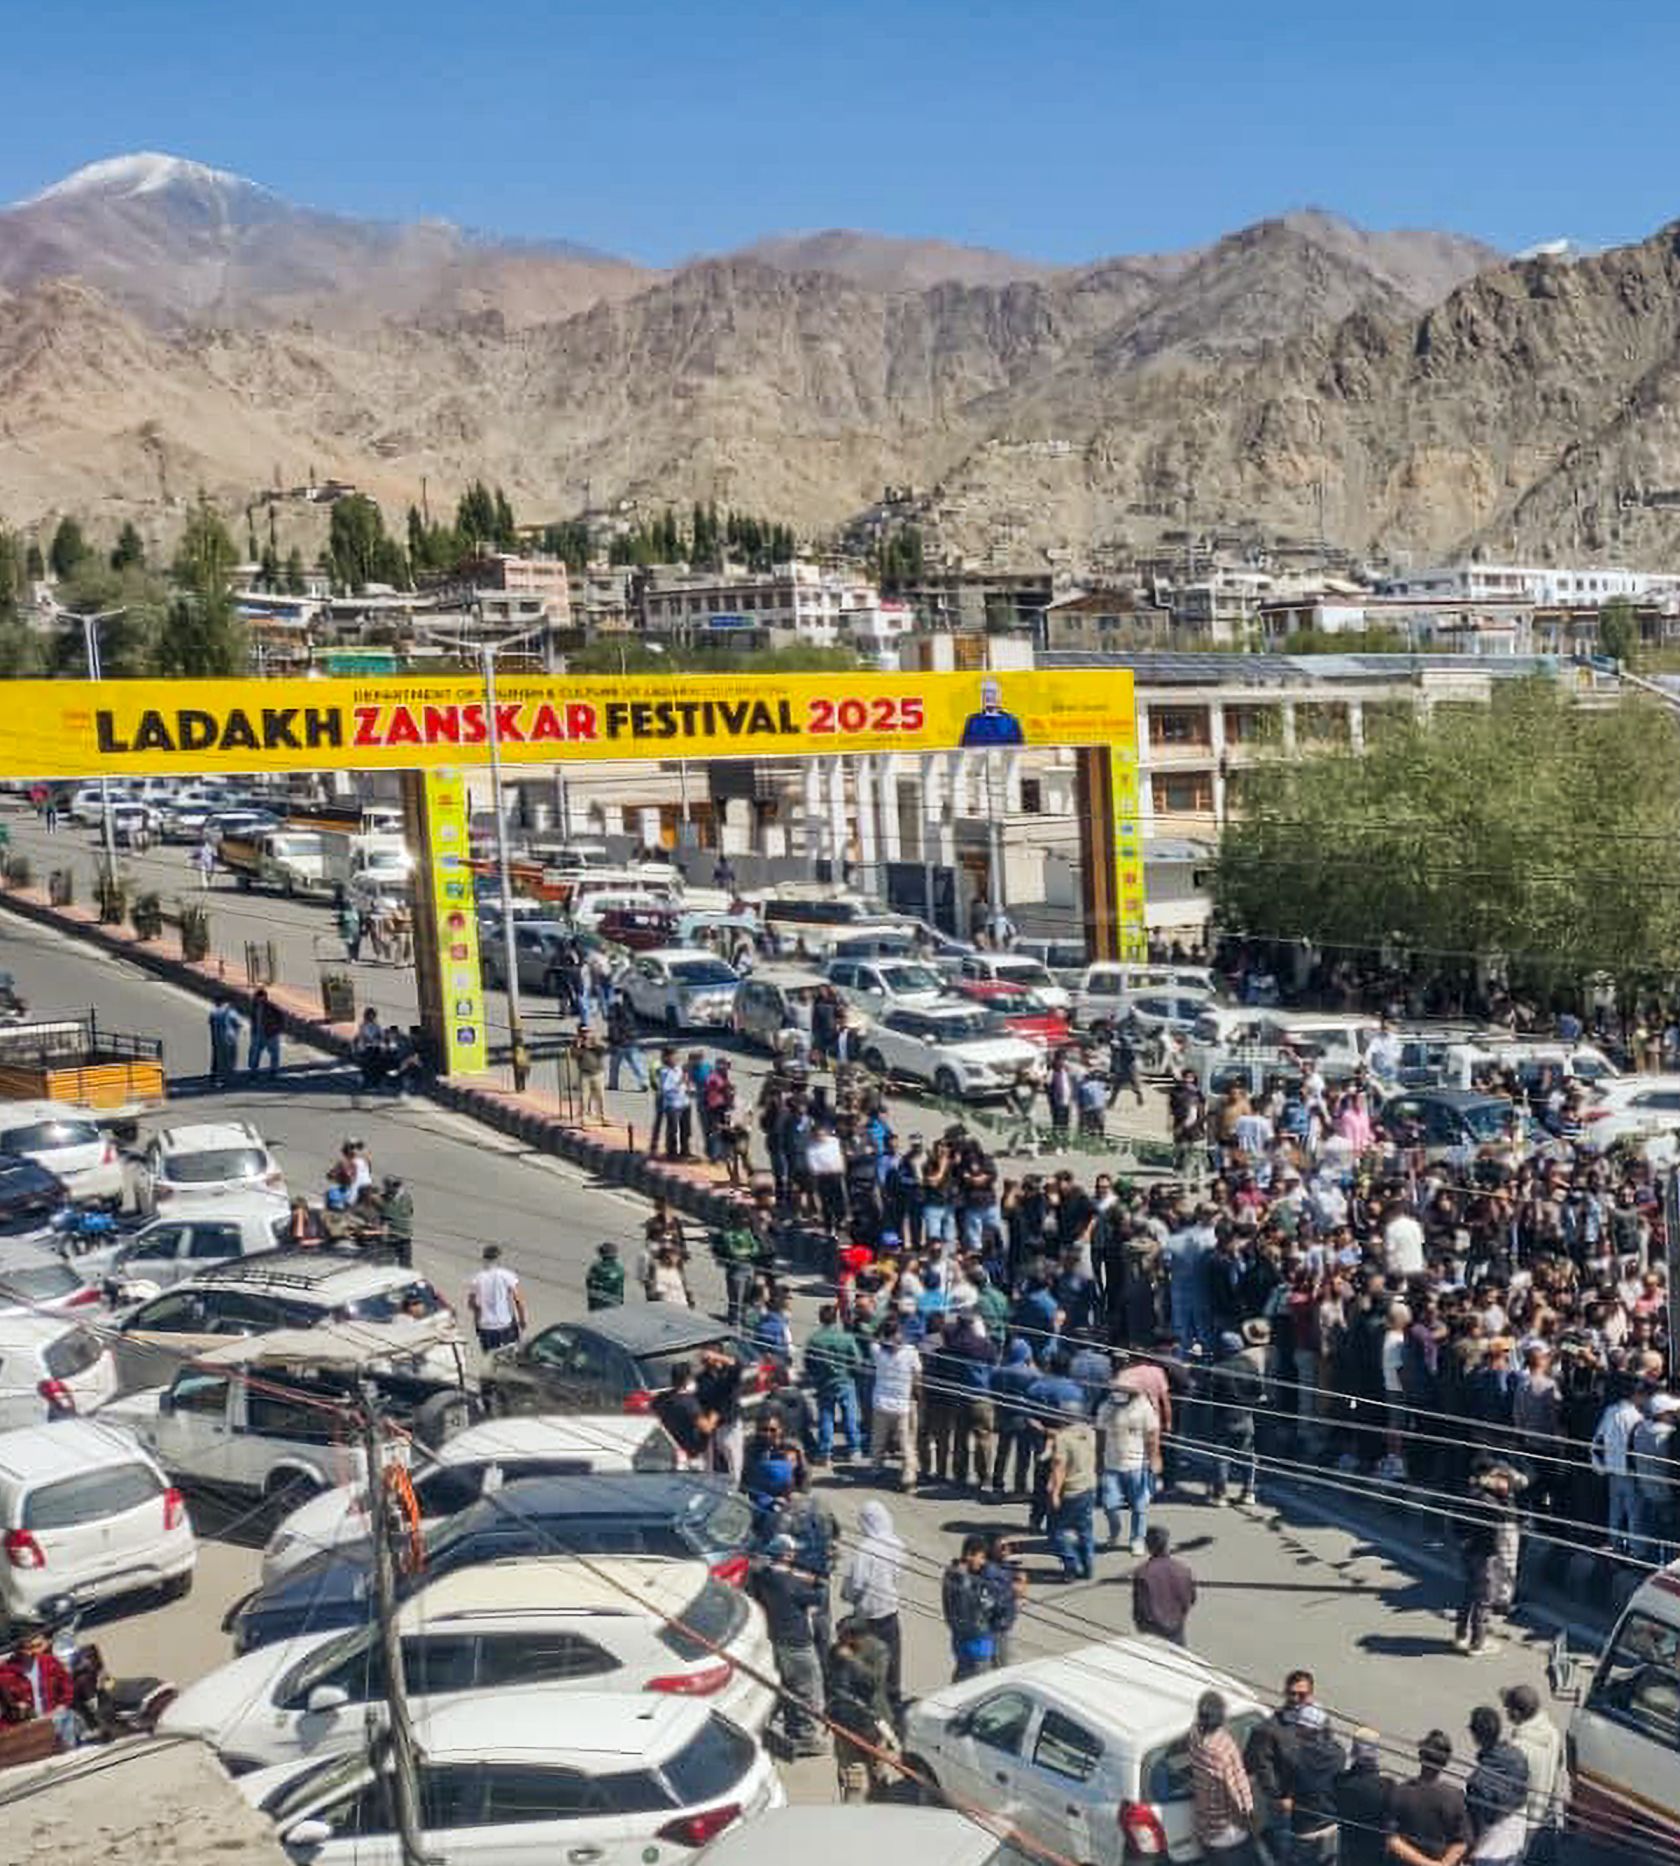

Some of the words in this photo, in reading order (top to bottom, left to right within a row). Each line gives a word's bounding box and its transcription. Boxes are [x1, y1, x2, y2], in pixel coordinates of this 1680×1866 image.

[96, 708, 343, 753] LADAKH
[353, 703, 598, 747] ZANSKAR
[605, 700, 799, 739] FESTIVAL
[809, 698, 923, 734] 2025
